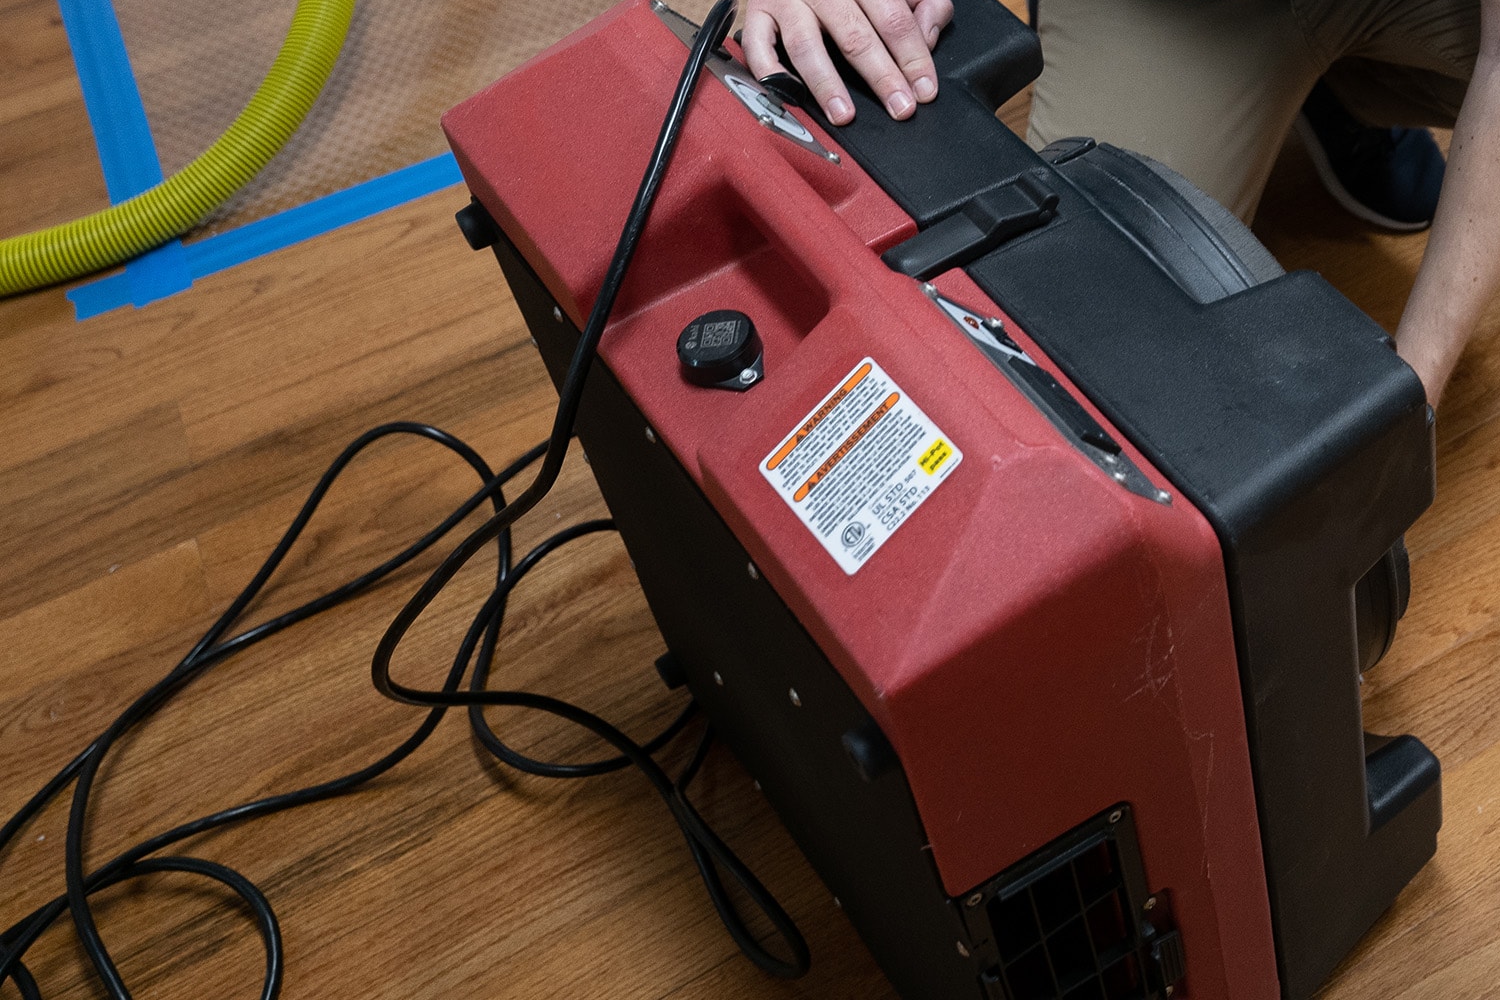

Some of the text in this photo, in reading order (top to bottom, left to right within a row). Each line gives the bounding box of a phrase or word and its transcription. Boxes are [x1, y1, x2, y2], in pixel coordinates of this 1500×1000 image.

[803, 388, 846, 432] WARNING
[815, 404, 888, 479] AVERTISSEMENT
[920, 442, 943, 465] Hi-Pot
[872, 501, 886, 514] UL
[885, 482, 903, 501] STD
[881, 505, 899, 525] CSA
[899, 486, 917, 505] STD
